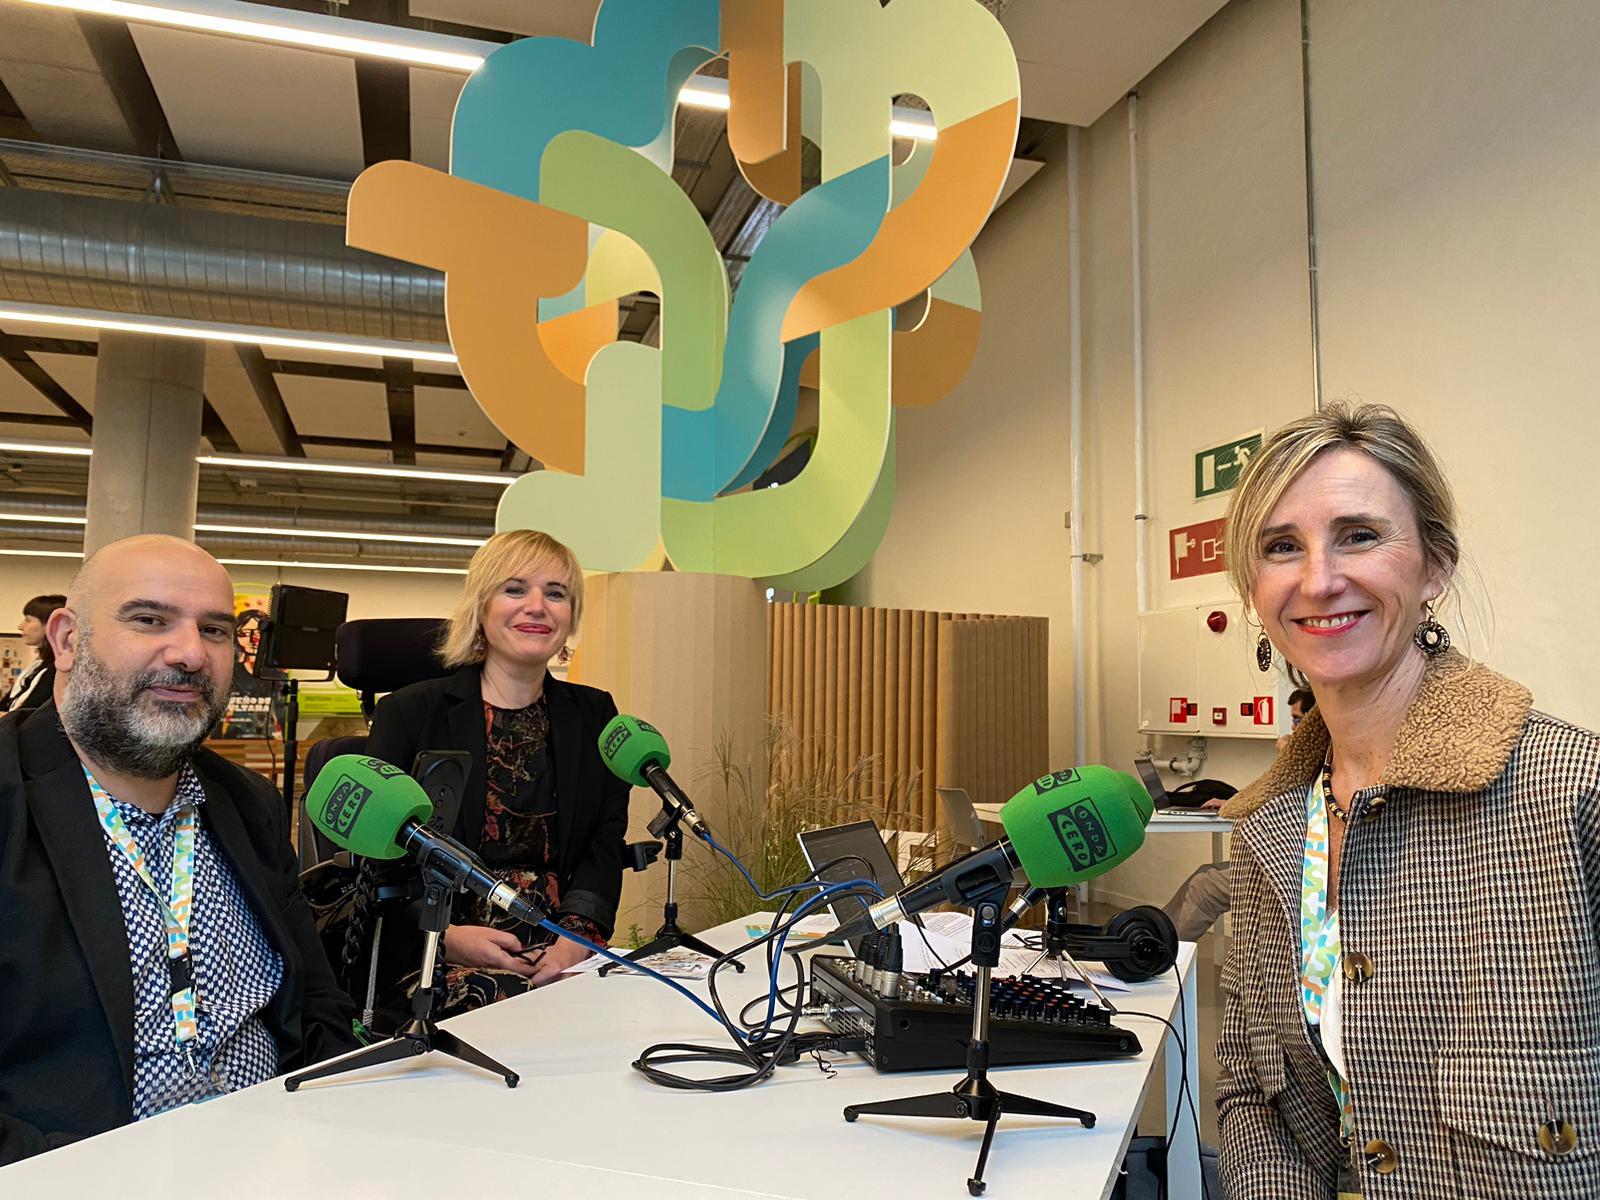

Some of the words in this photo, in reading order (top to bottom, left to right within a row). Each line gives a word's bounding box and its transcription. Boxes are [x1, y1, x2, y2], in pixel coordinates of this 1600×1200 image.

[327, 785, 350, 820] ONDA
[339, 792, 361, 826] CERO
[1061, 819, 1088, 860] CERO
[1078, 812, 1105, 855] ONDA
